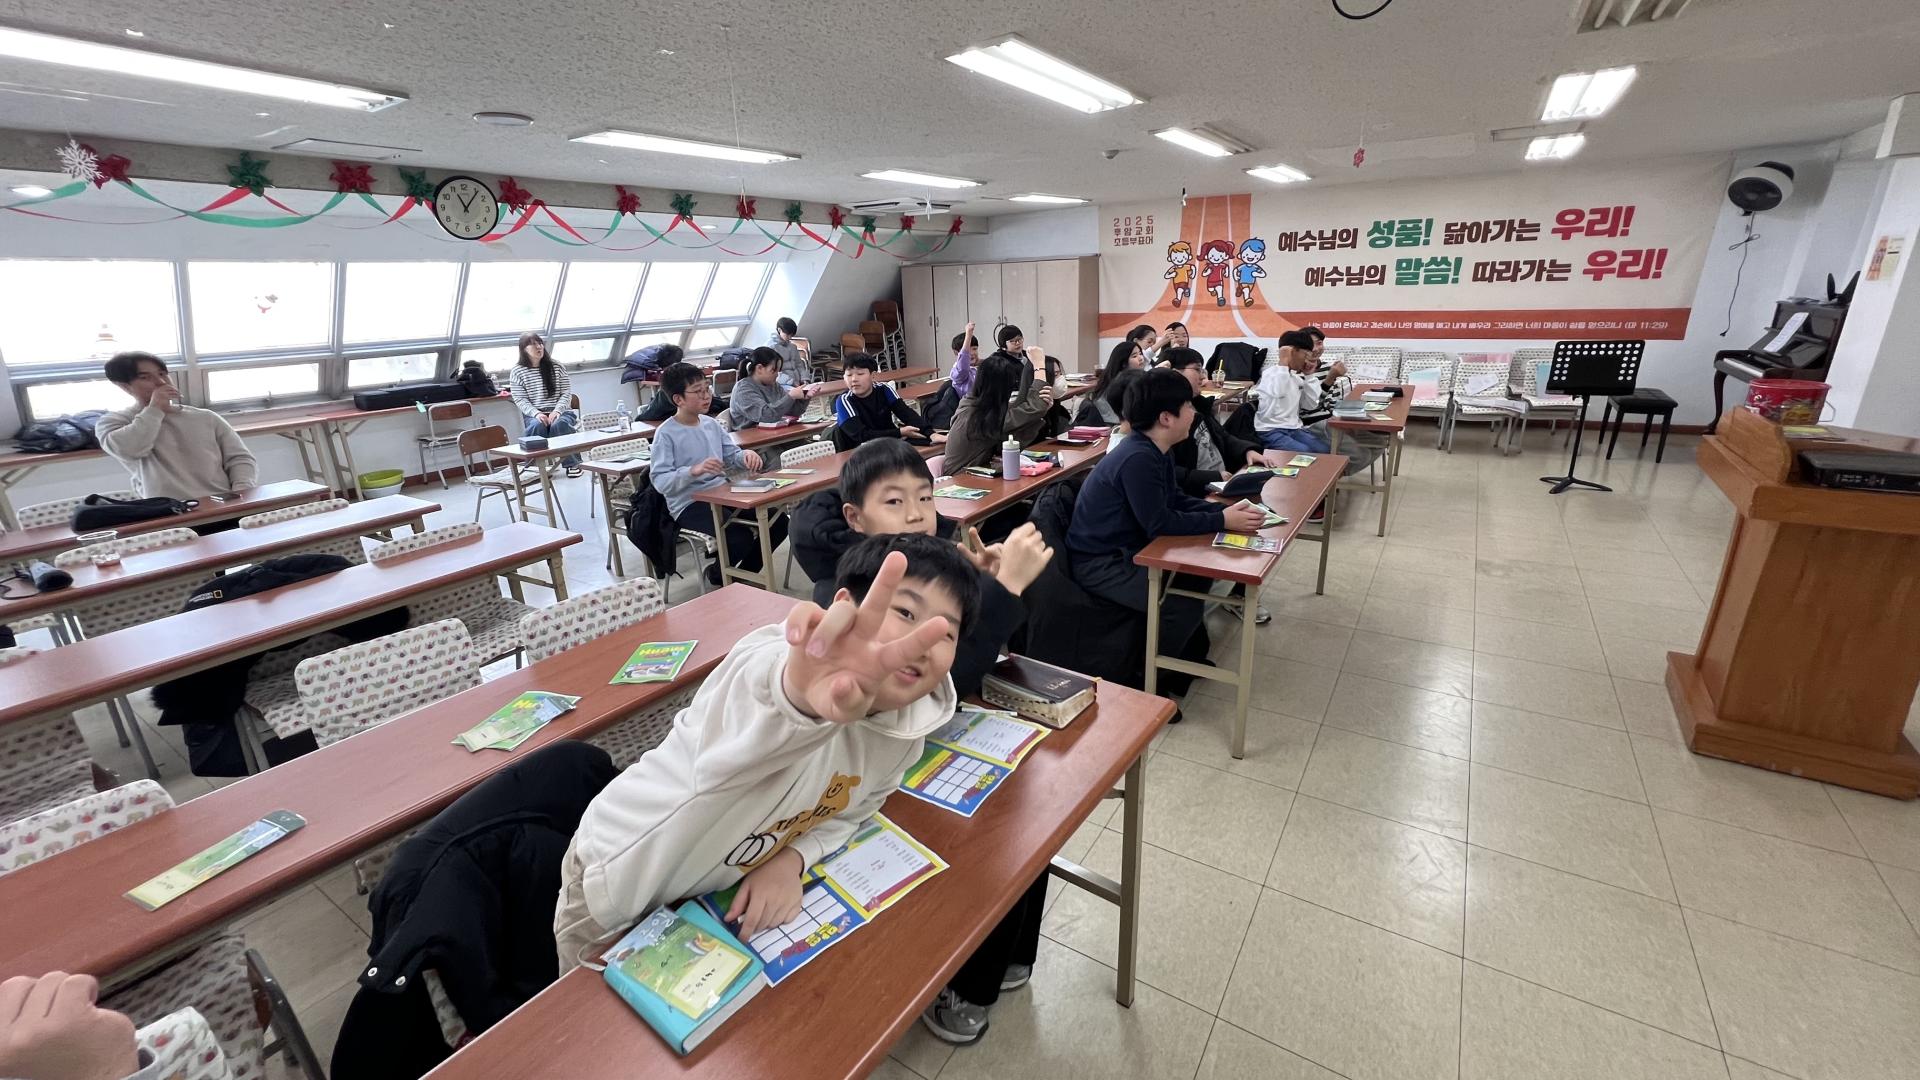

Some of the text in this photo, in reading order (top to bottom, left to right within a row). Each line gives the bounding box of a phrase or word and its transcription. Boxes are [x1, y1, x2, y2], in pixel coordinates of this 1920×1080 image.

[442, 193, 450, 201] 10
[1278, 205, 1636, 252] 예수님의 성품! 닮아가는 우리!
[1113, 236, 1154, 247] 초등부표어
[1304, 248, 1669, 287] 예수님의 말씀! 따라가는 우리!
[1343, 321, 1369, 330] 온유하고
[1398, 321, 1412, 330] 나의
[1435, 321, 1450, 330] 메고
[1452, 321, 1467, 330] 내게
[1525, 321, 1541, 330] 너희
[1543, 321, 1567, 330] 마음이
[1641, 321, 1669, 330] 11:29)
